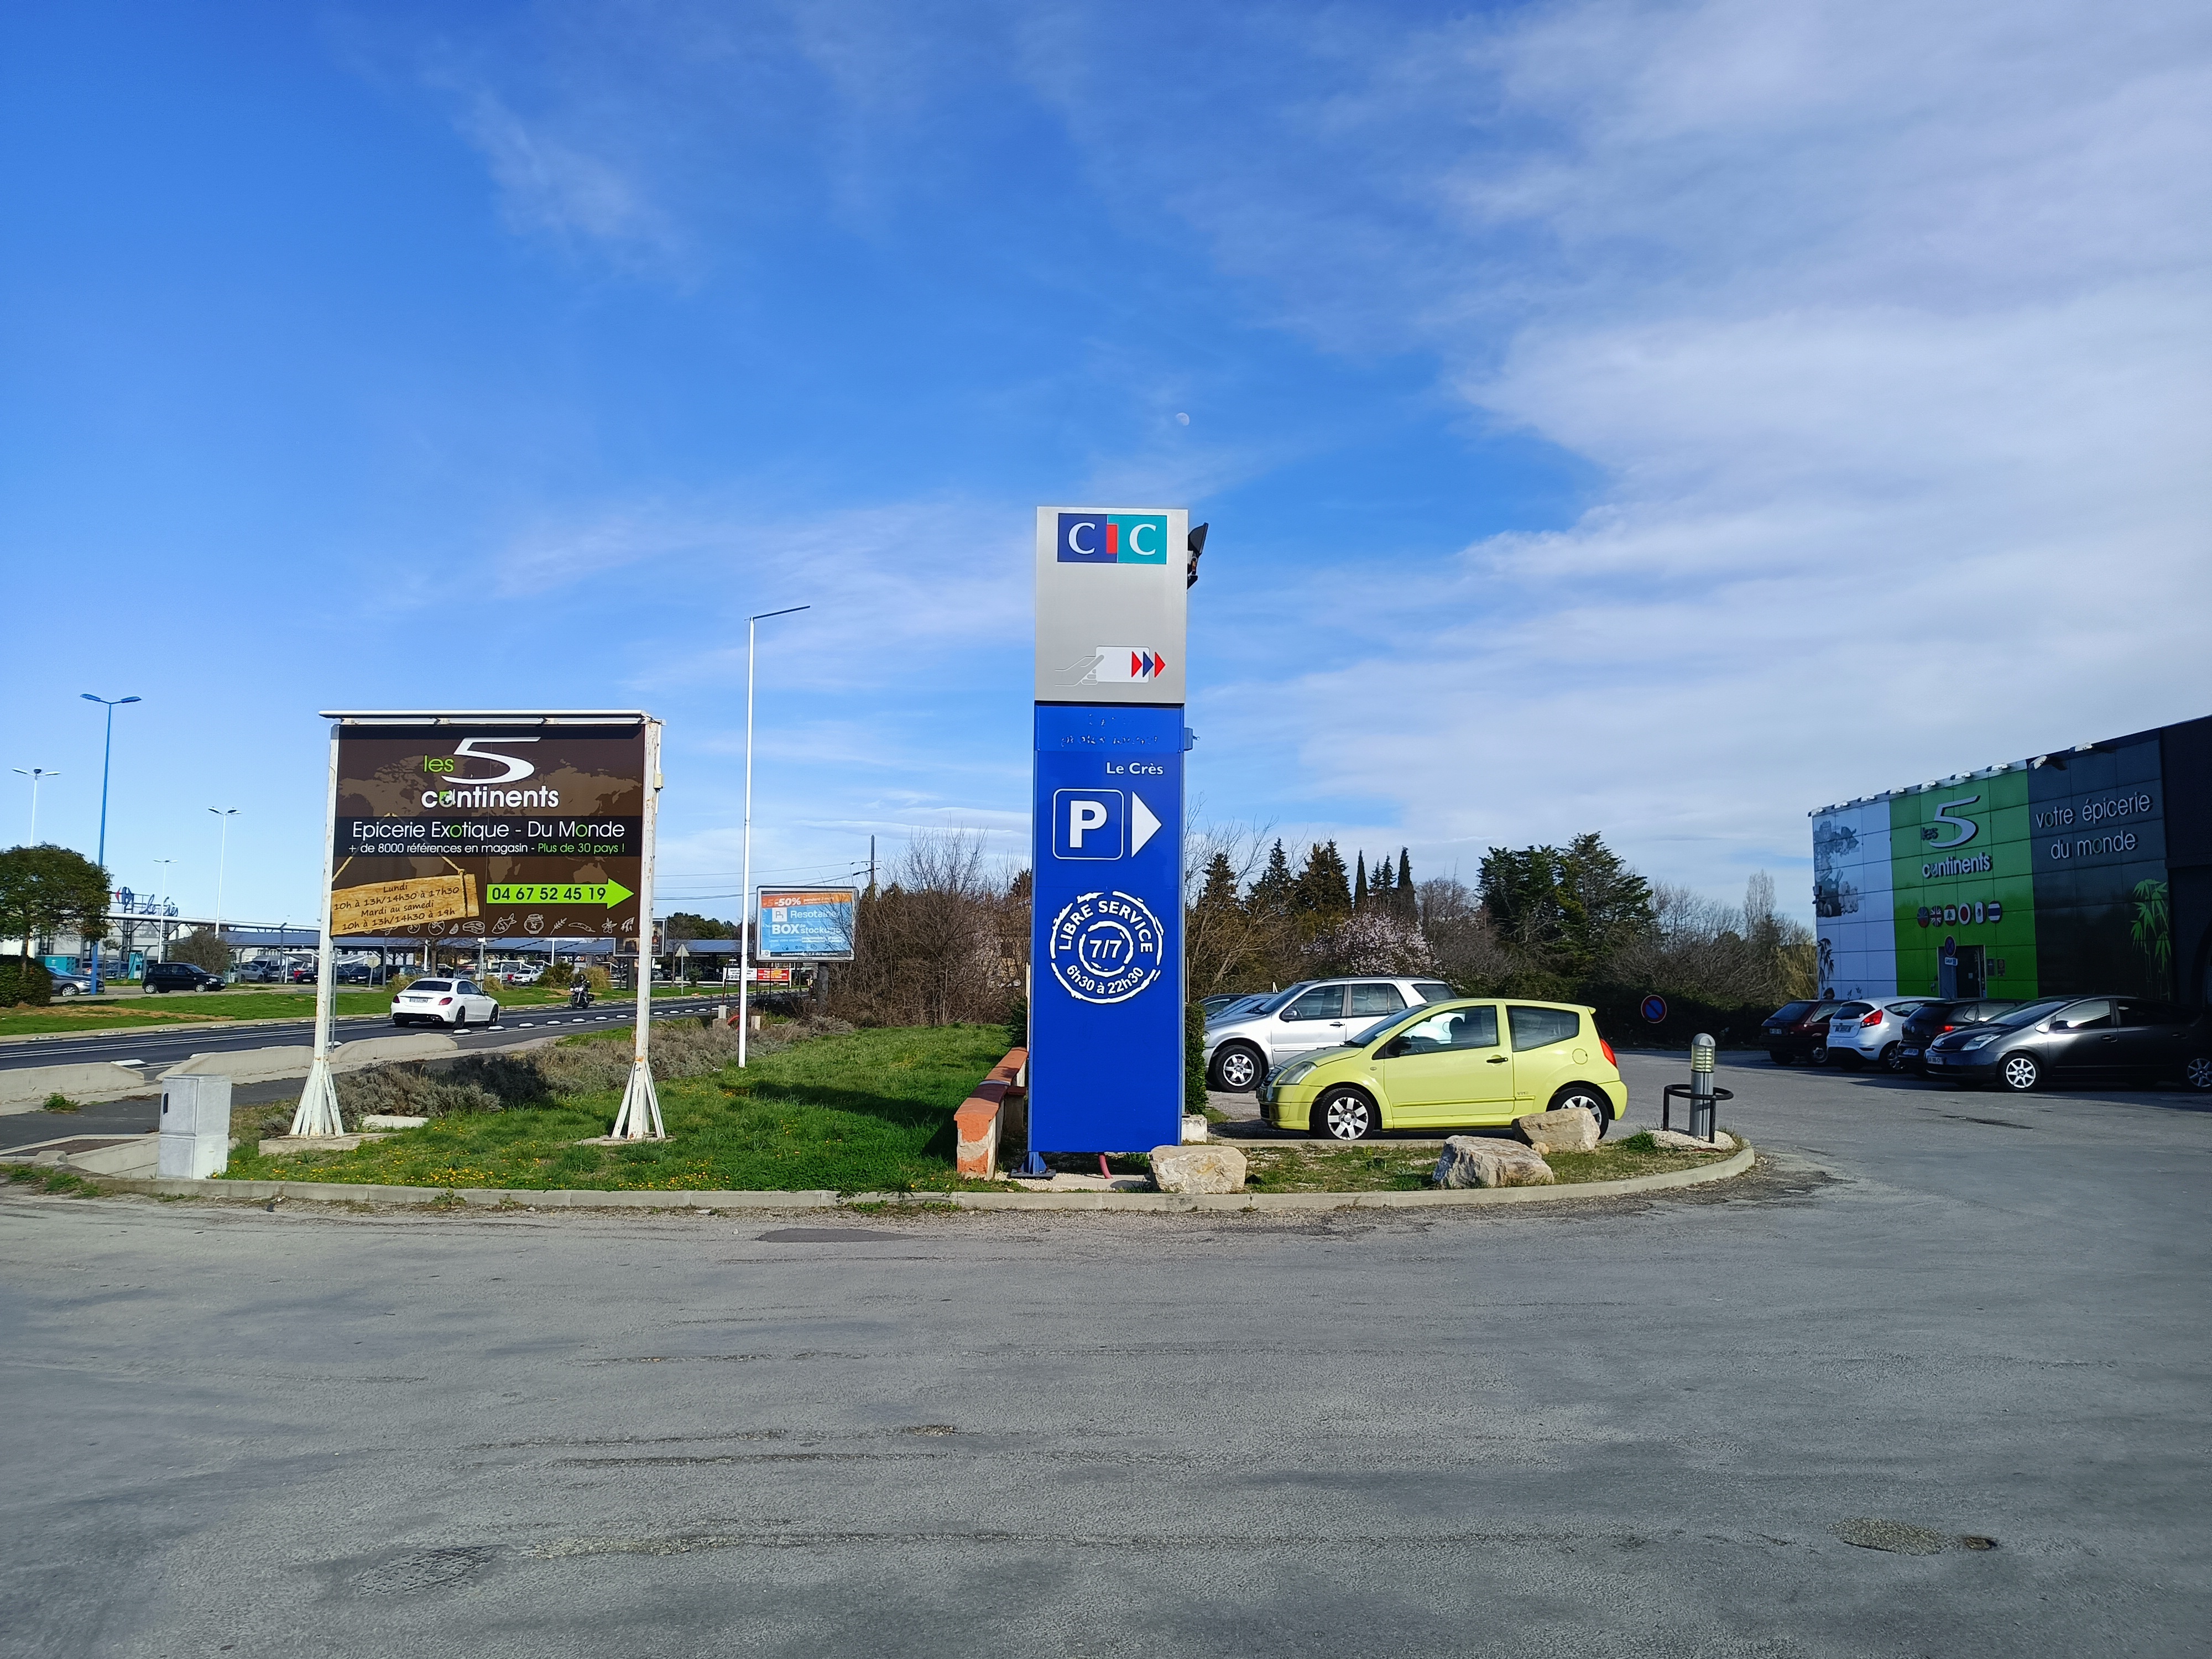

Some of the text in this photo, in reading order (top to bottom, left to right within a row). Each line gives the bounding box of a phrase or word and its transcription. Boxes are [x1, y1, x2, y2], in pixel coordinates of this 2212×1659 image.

[1067, 521, 1157, 556] CIC
[424, 737, 541, 784] les 5
[1107, 762, 1164, 775] Le Crès
[421, 785, 560, 808] continents
[2036, 792, 2151, 828] votre épicerie
[353, 821, 425, 841] Epicerie
[431, 821, 509, 841] Exotique
[528, 821, 552, 837] Du
[559, 821, 625, 837] Monde
[1070, 800, 1107, 848] P
[1929, 795, 1980, 849] 5
[360, 843, 375, 853] de
[378, 843, 404, 853] 8000
[407, 842, 462, 853] références
[482, 843, 528, 854] magasin
[538, 843, 557, 853] Plus
[560, 843, 575, 853] de
[577, 843, 591, 853] 30
[593, 845, 618, 854] pays
[2051, 830, 2136, 859] du monde
[334, 886, 460, 911] 10h à 13h/14h30 à 17h30
[383, 882, 408, 893] Lundi
[492, 888, 606, 900] 04 67 52 45 19
[361, 906, 387, 917] Mardi
[404, 900, 435, 911] samedi
[775, 897, 801, 906] -50%
[342, 907, 456, 931] 10h à 13h/14h30 à 19h
[790, 910, 840, 919] Resotaine
[1058, 900, 1153, 952] LIBRE SERVICE
[772, 924, 800, 935] BOX
[1089, 940, 1122, 958] 7/7
[1067, 965, 1144, 994] 6h30 à 22h30
